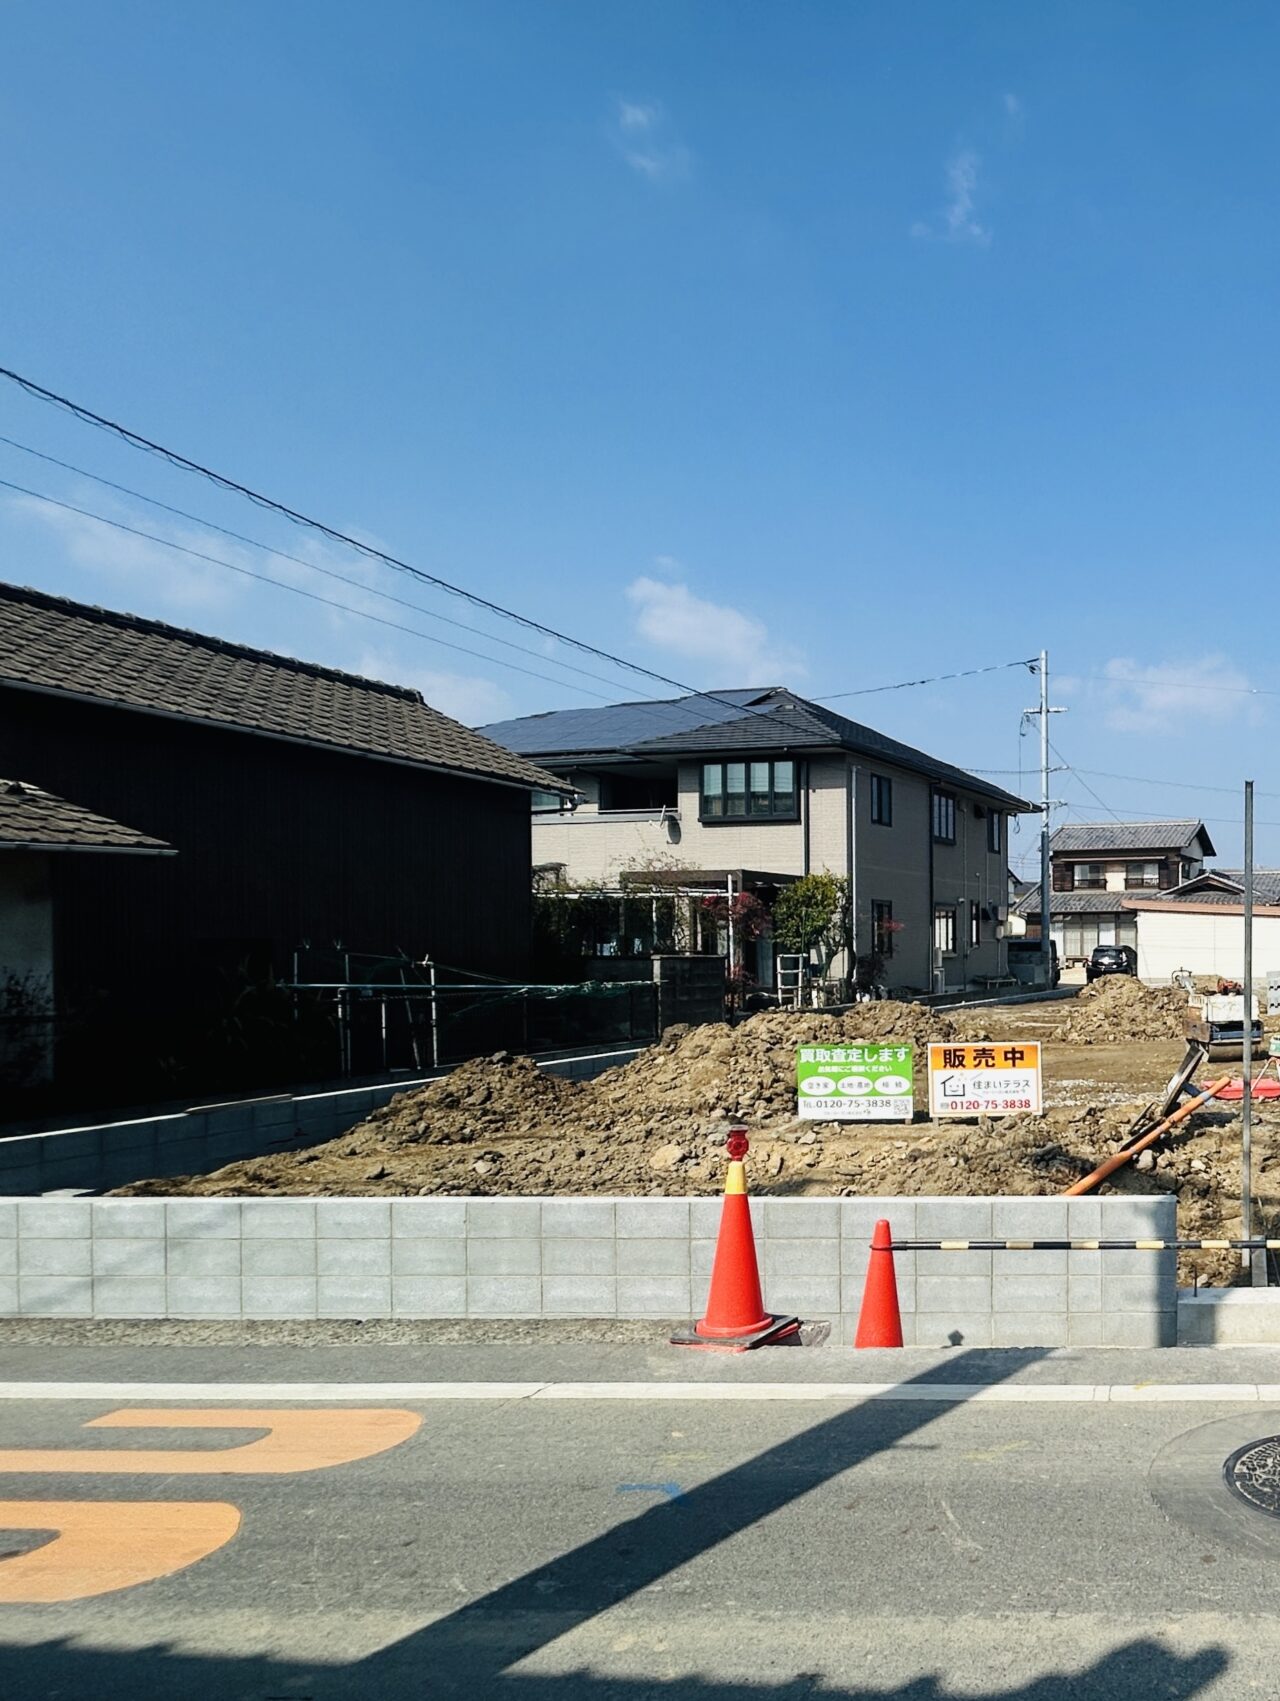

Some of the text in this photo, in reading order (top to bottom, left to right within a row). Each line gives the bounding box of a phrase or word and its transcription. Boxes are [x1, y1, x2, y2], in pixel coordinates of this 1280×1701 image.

[799, 1046, 910, 1063] 買取査定します
[943, 1047, 1025, 1069] 販売中
[972, 1079, 1031, 1090] 住まいテラス
[816, 1099, 892, 1109] 0120-75-3838
[950, 1099, 1032, 1110] 0120-75-3838
